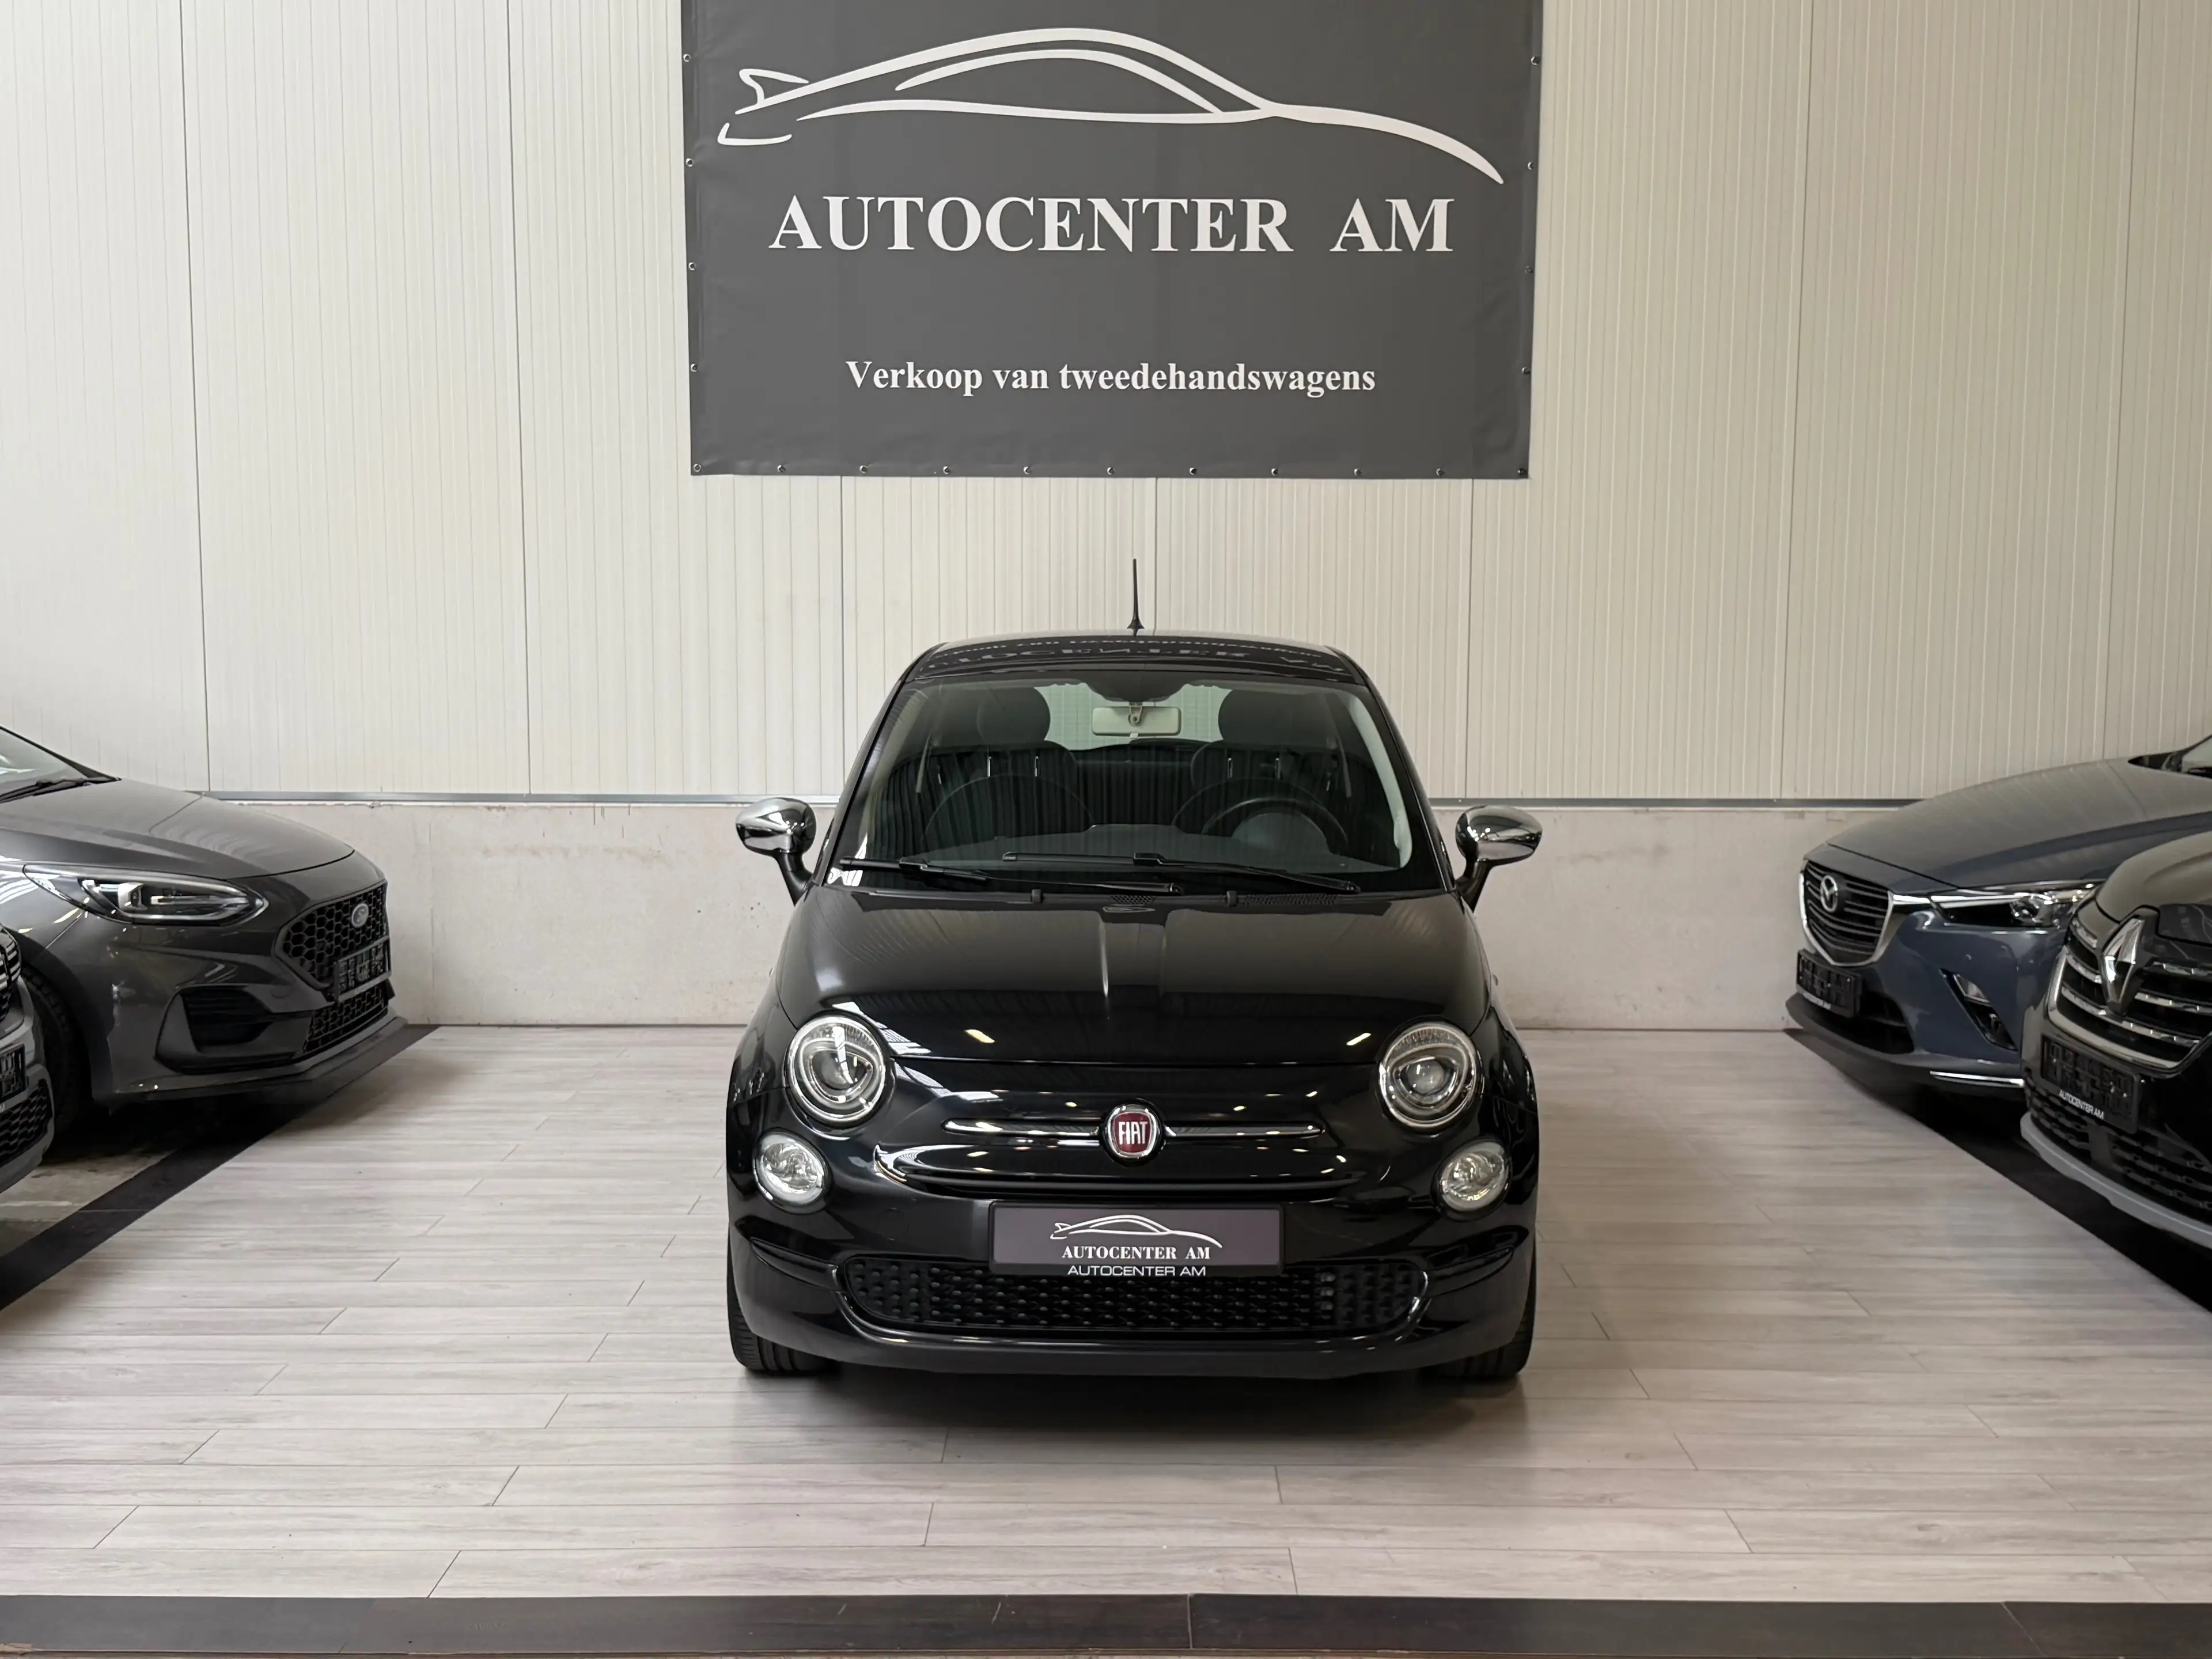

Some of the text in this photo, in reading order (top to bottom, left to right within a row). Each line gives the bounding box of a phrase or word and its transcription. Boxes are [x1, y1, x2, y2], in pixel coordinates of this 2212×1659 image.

[768, 195, 1455, 253] AUTOCENTER AM
[846, 361, 1376, 399] Verkoop van tweedehandswagens
[2059, 1089, 2094, 1114] AUTOCENTER
[1118, 1121, 1148, 1145] FIAT
[1062, 1245, 1210, 1260] AUTOCENTER AM
[1067, 1265, 1206, 1277] AUTOCENTER AM
